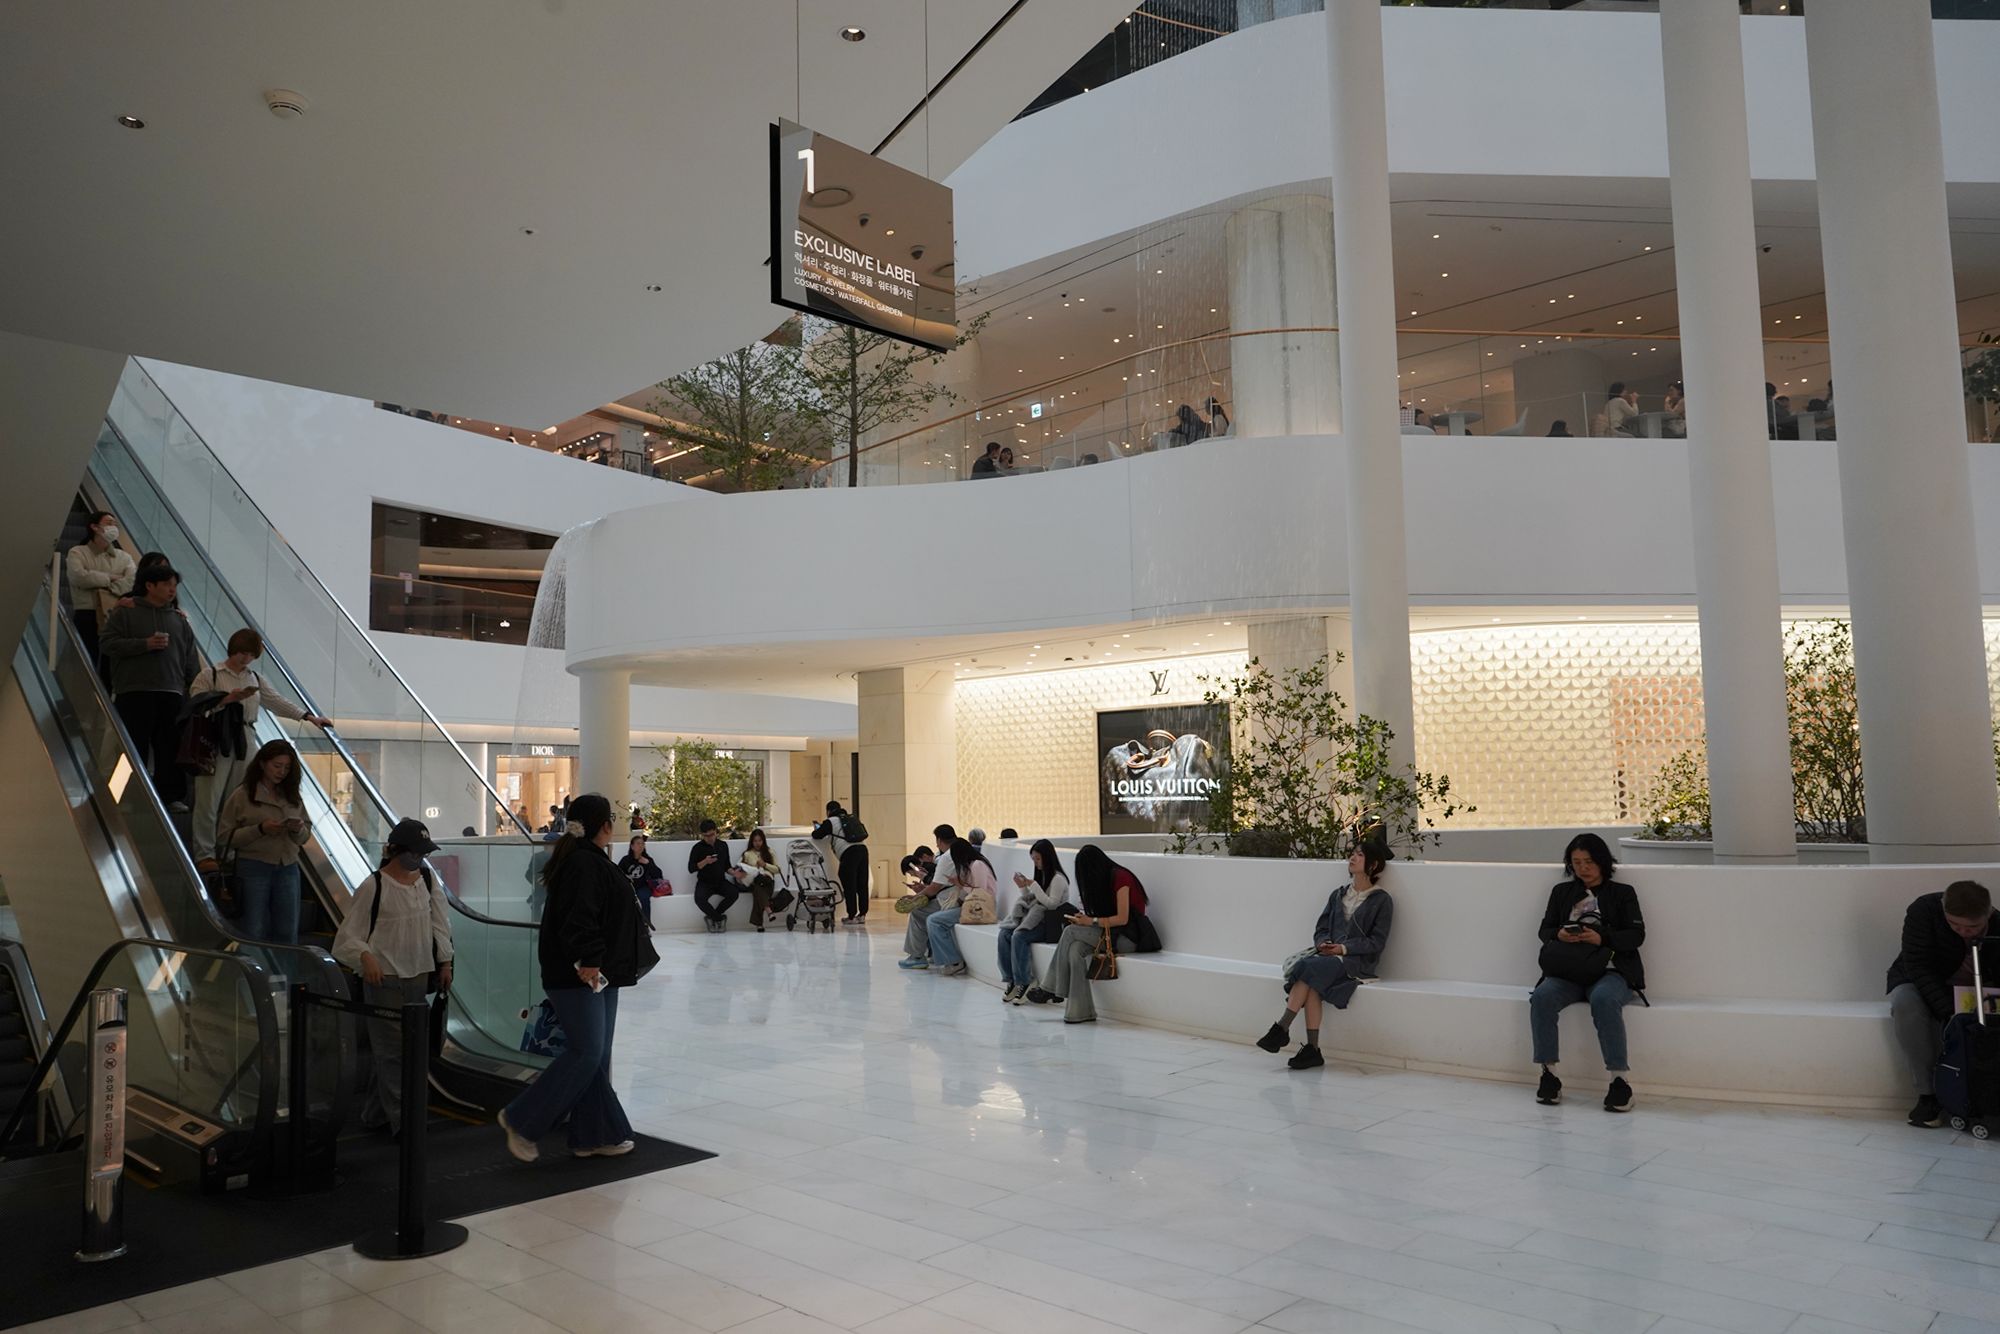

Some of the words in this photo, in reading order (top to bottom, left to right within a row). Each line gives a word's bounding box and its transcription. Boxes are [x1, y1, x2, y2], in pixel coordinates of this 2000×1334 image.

[798, 148, 815, 194] 1
[794, 230, 874, 271] EXCLUSIVE
[877, 259, 920, 287] LABEL
[794, 251, 818, 269] 럭셔리
[823, 261, 846, 278] 주얼리
[851, 271, 873, 288] 화장품
[794, 266, 822, 281] LUXURY
[825, 277, 855, 293] JEWELRY
[794, 277, 834, 296] COSMETICS
[838, 290, 876, 310] WATERFALL
[876, 302, 903, 317] GARDEN
[531, 745, 555, 756] DIOR
[1111, 779, 1154, 796] LOUIS
[1156, 777, 1222, 795] VUITTON
